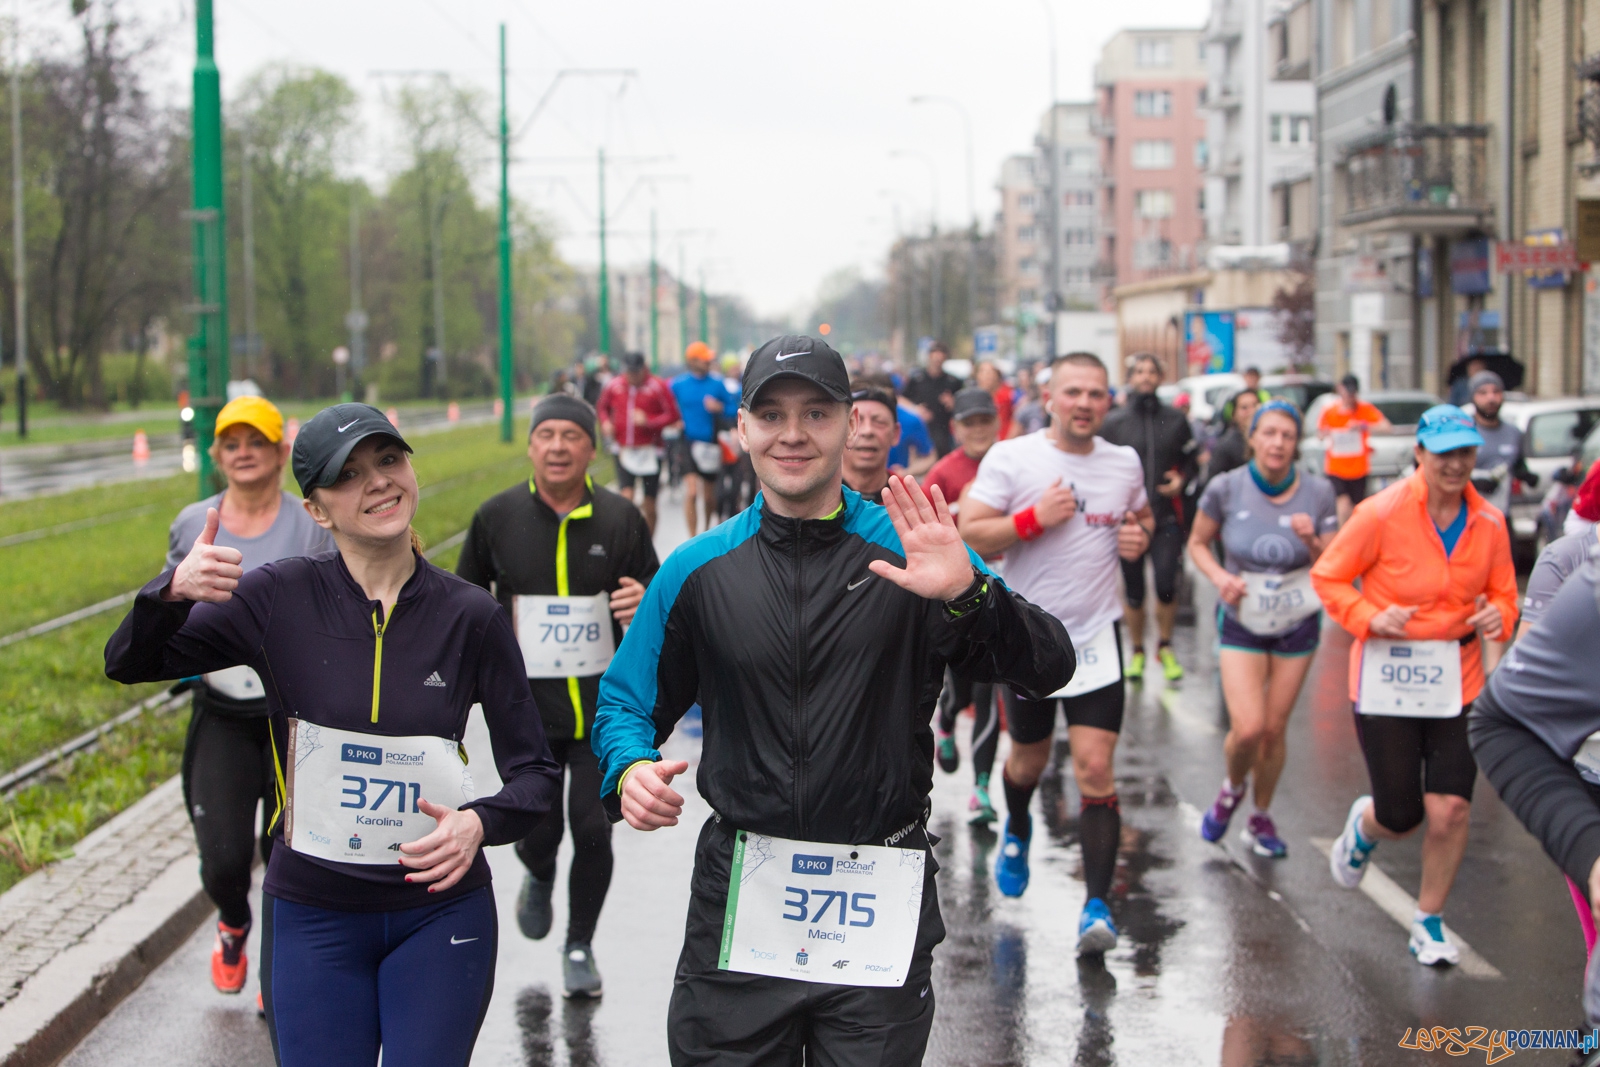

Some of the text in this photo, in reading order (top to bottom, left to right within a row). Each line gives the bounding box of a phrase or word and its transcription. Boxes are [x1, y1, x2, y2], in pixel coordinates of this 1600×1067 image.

[539, 622, 600, 643] 7078
[1381, 664, 1443, 685] 9052
[356, 750, 377, 760] PKO
[340, 774, 421, 813] 3711
[356, 814, 403, 828] Karolina
[311, 833, 331, 845] posir
[807, 860, 827, 870] PKO
[783, 886, 876, 928] 3715
[808, 929, 846, 943] Maciej
[754, 950, 778, 961] posir
[832, 959, 850, 969] 4F
